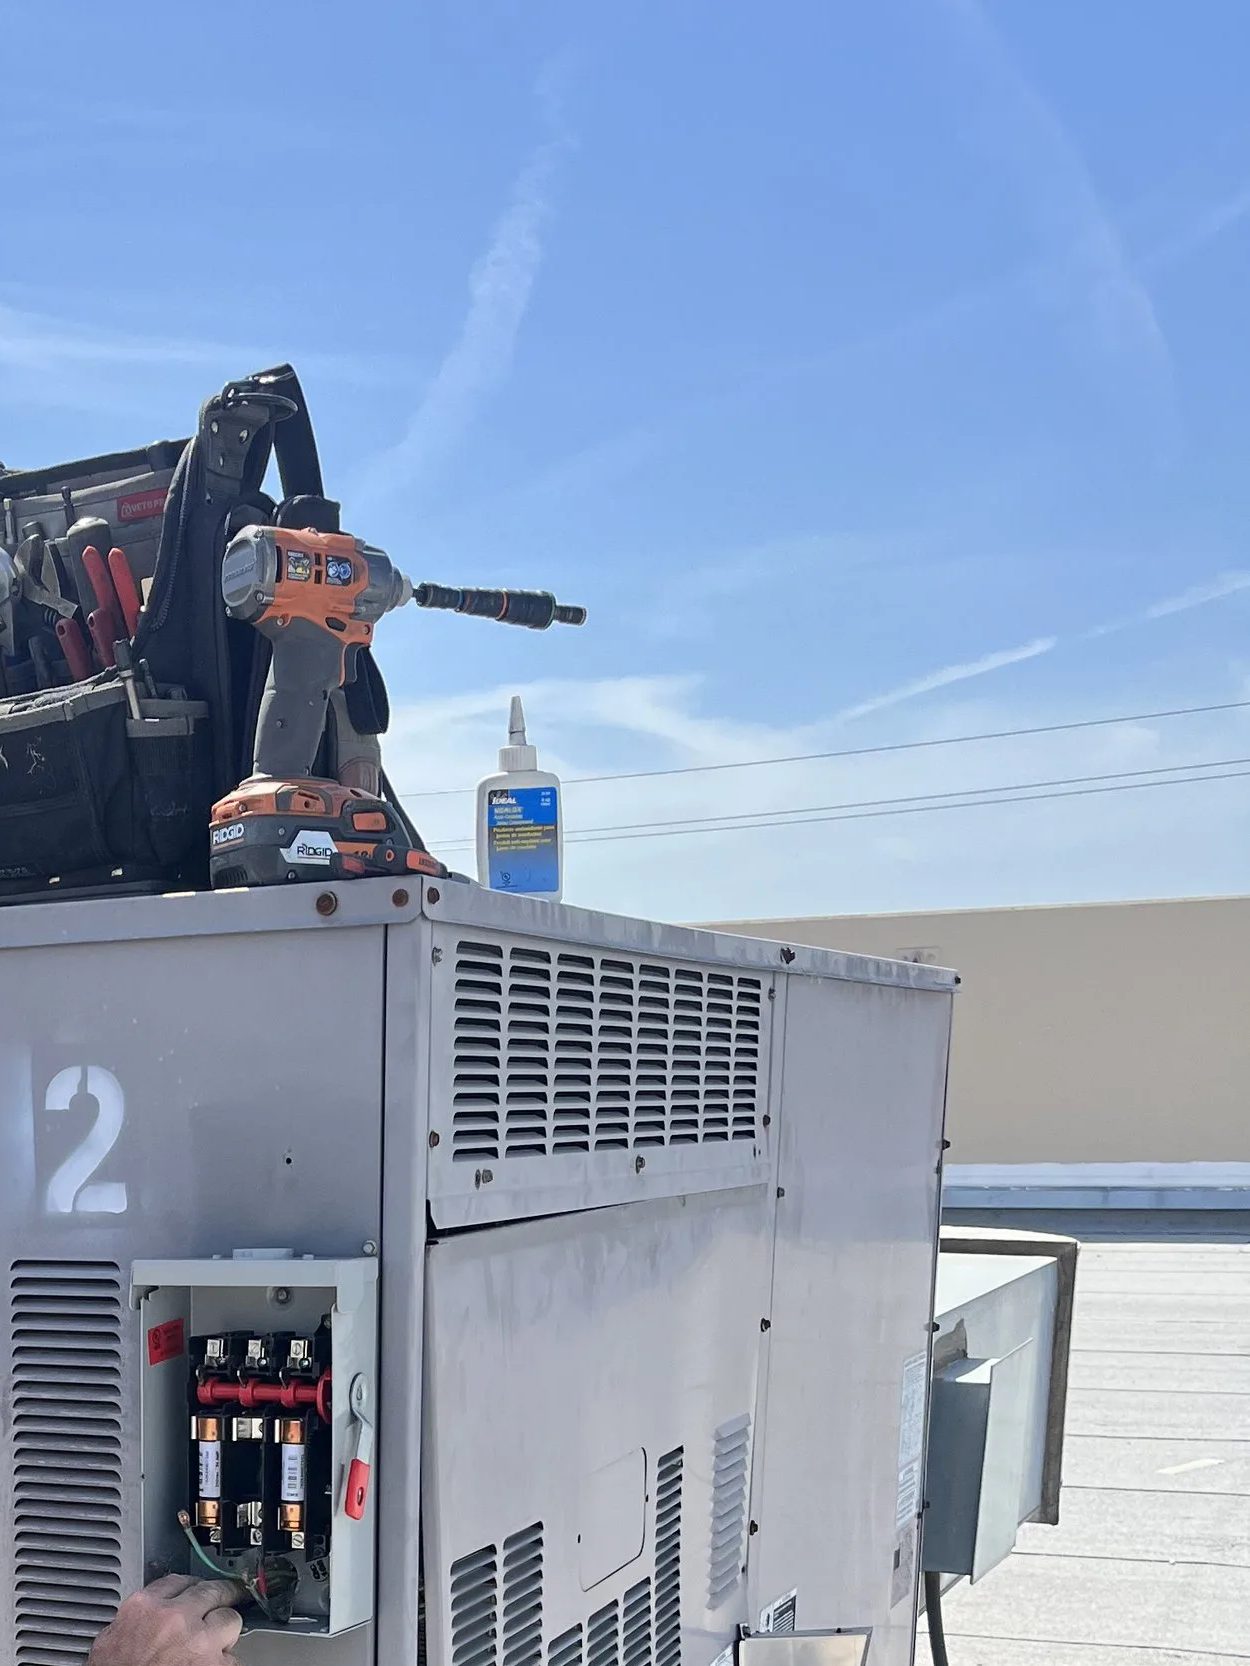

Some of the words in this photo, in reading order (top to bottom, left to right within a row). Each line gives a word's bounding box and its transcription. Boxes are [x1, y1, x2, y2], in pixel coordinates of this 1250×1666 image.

[492, 797, 517, 805] IDEAL
[213, 823, 244, 845] RIDGID
[297, 844, 333, 857] RIDGID
[45, 1065, 127, 1213] 2
